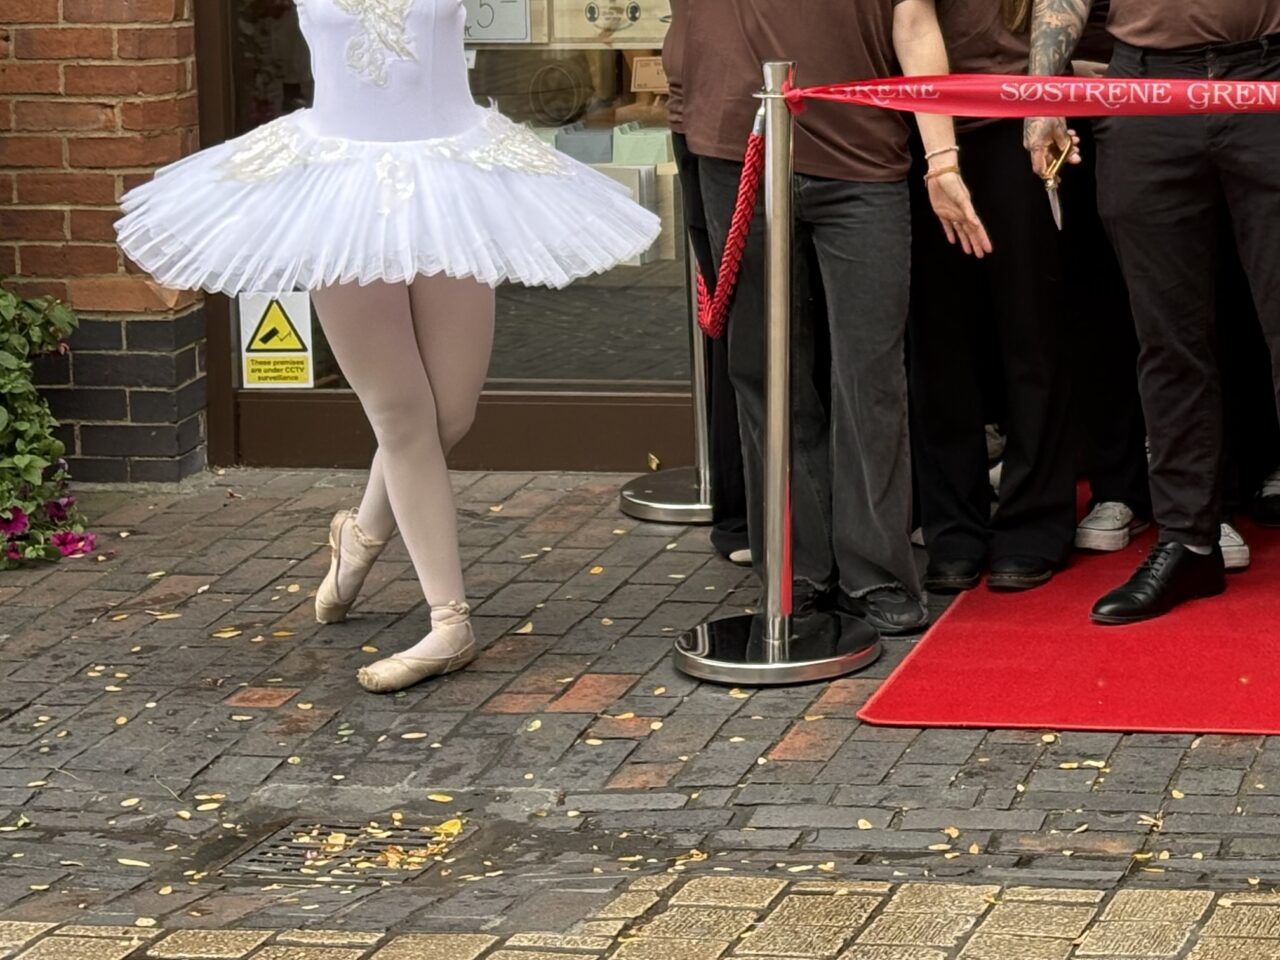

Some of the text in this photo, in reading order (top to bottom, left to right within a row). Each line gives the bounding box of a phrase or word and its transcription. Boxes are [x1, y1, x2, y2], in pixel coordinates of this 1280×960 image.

[831, 84, 941, 105] RENE
[1000, 82, 1172, 109] SØSTRENE
[272, 359, 305, 367] premises
[284, 366, 305, 374] CCTV
[257, 374, 299, 382] surveillance
